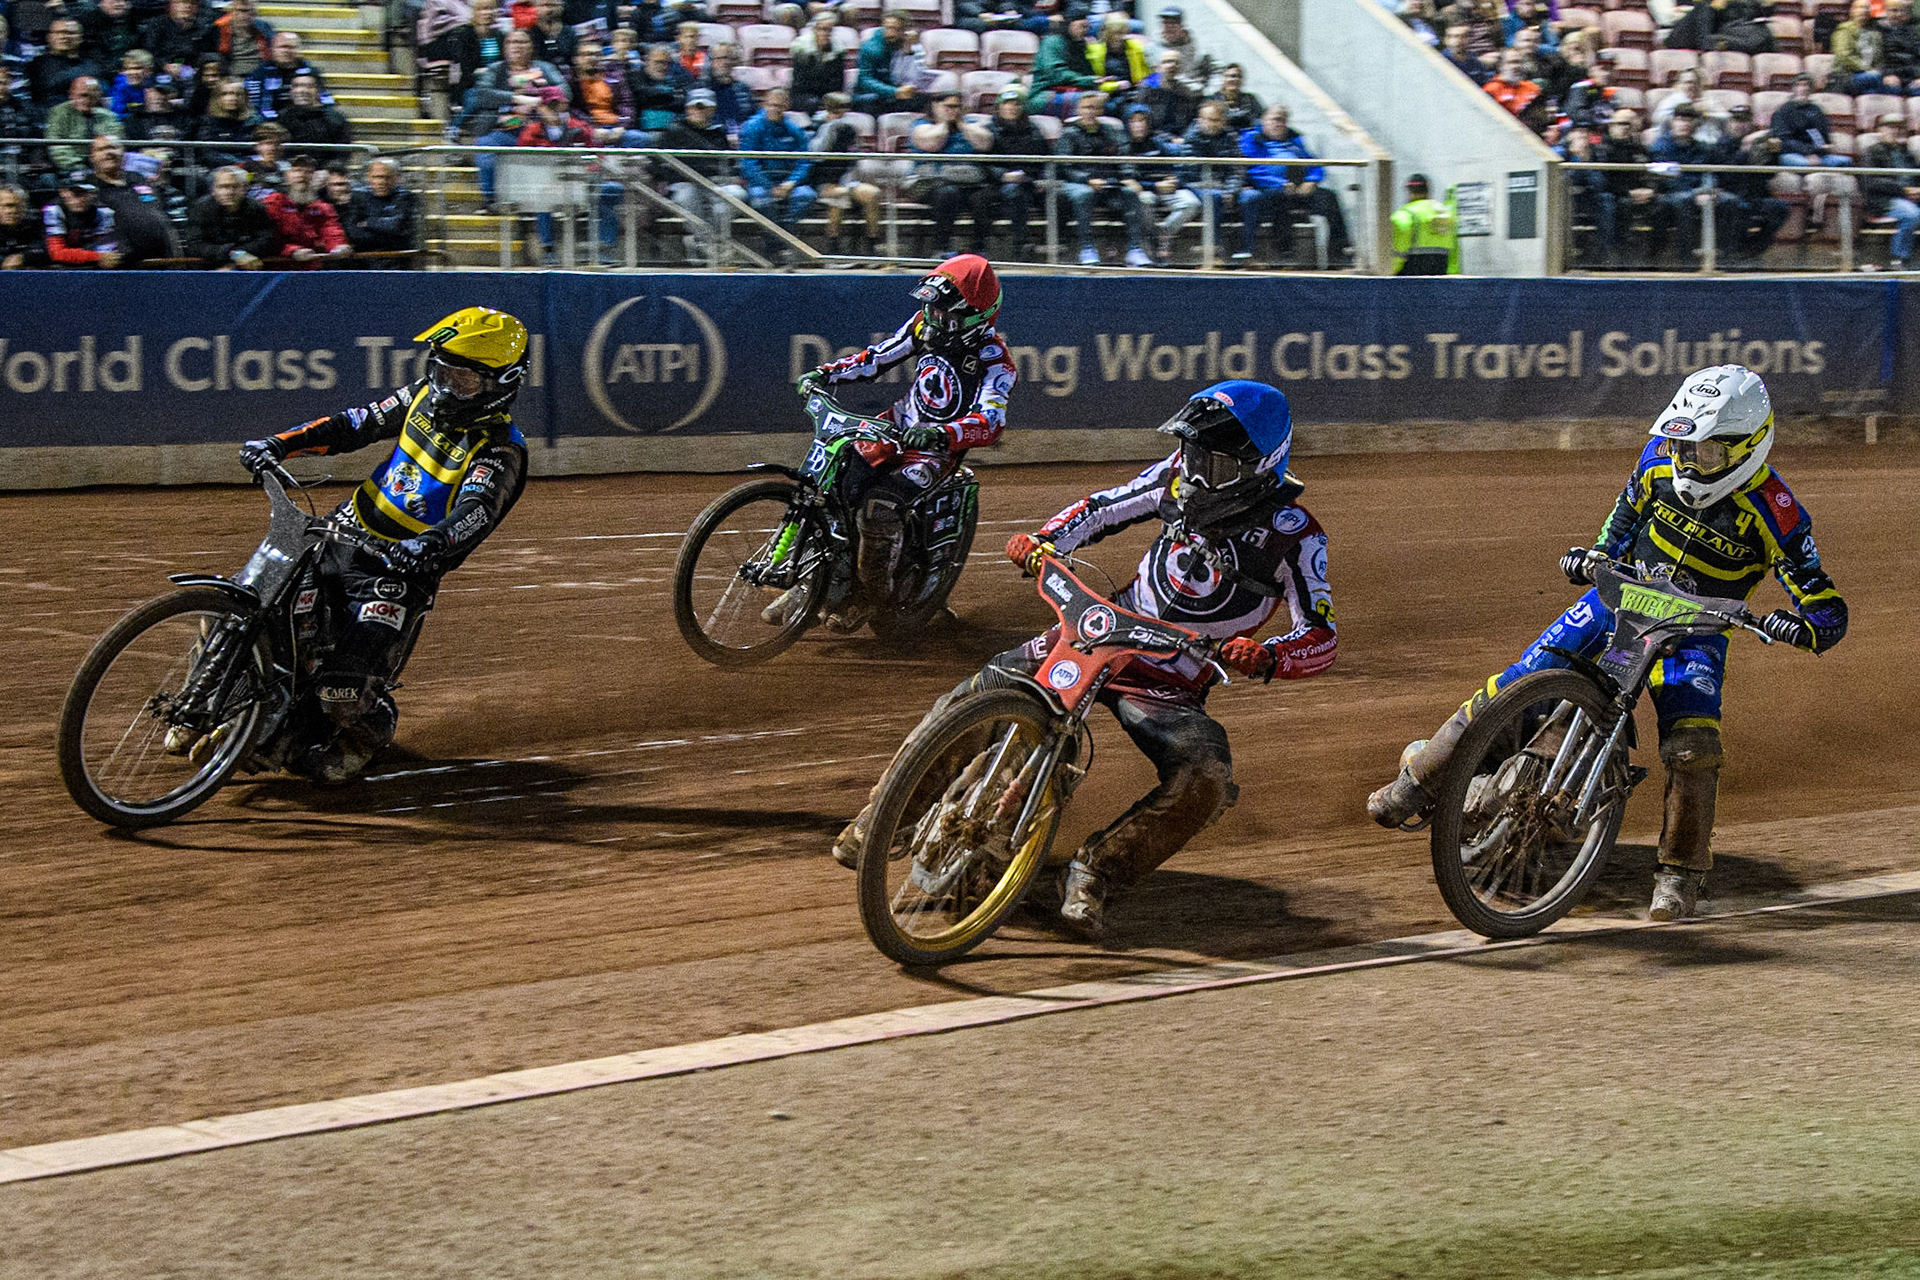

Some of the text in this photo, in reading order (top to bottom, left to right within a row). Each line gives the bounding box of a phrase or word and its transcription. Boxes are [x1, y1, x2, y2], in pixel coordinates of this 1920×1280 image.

[166, 333, 338, 392] Class
[605, 343, 700, 384] ATPI
[1096, 331, 1258, 382] World
[1271, 331, 1414, 381] Class
[1426, 329, 1584, 380] Travel
[1598, 327, 1827, 377] Solutions
[1682, 521, 1751, 558] PLANT
[363, 603, 401, 621] NGK
[1055, 668, 1075, 682] ATPI
